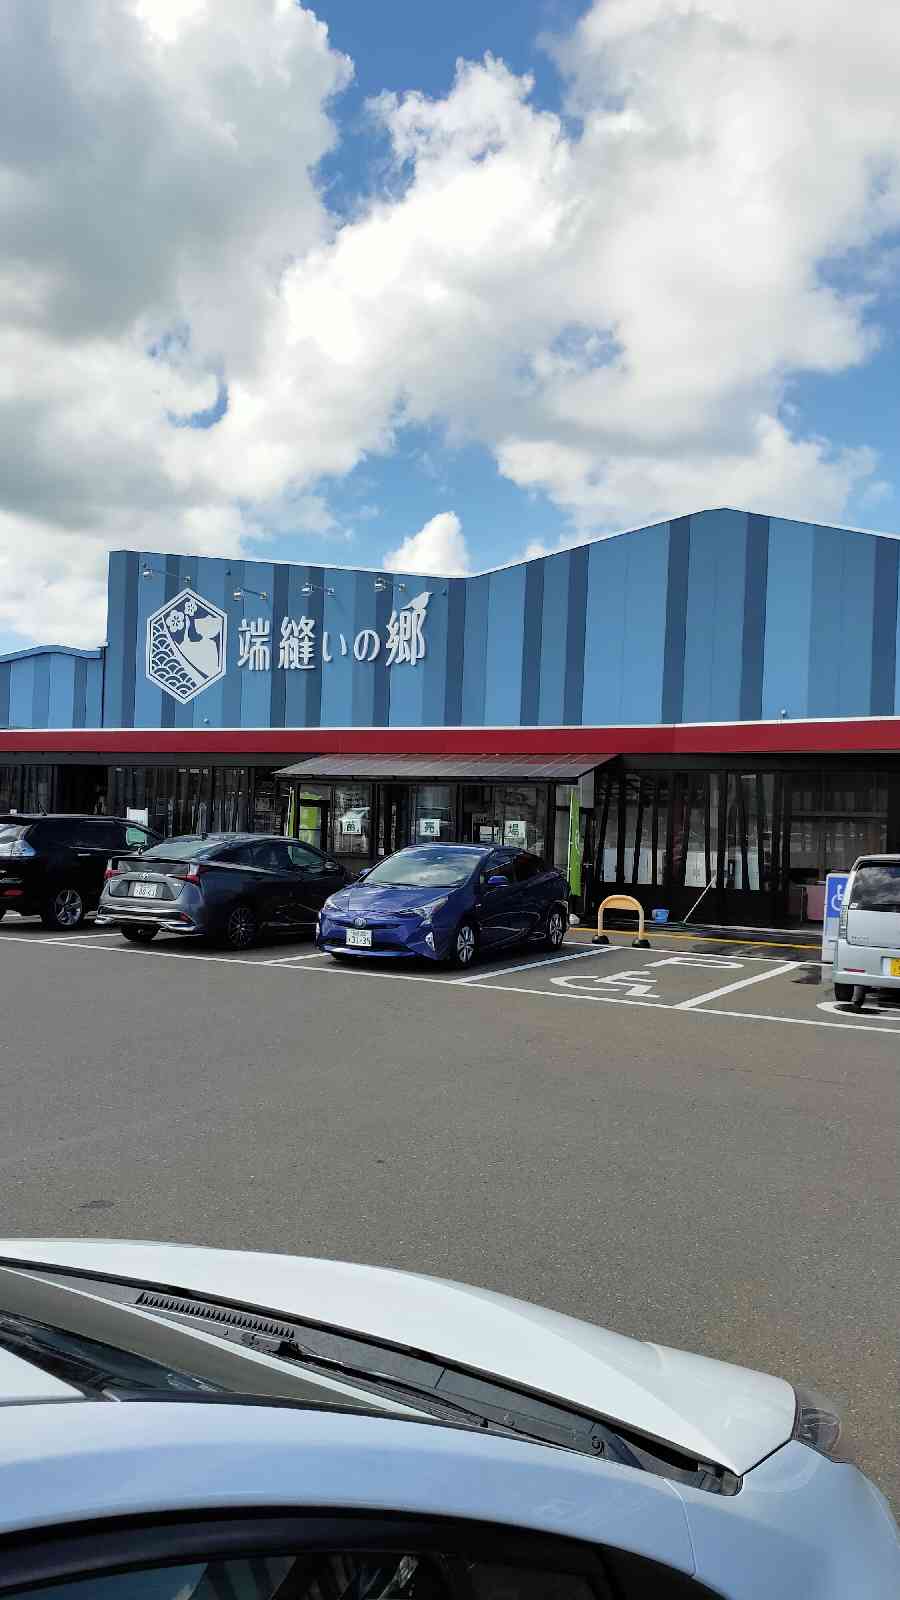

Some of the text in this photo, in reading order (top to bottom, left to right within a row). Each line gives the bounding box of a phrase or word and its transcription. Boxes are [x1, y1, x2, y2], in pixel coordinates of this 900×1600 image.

[237, 608, 427, 671] 端縫いの郷
